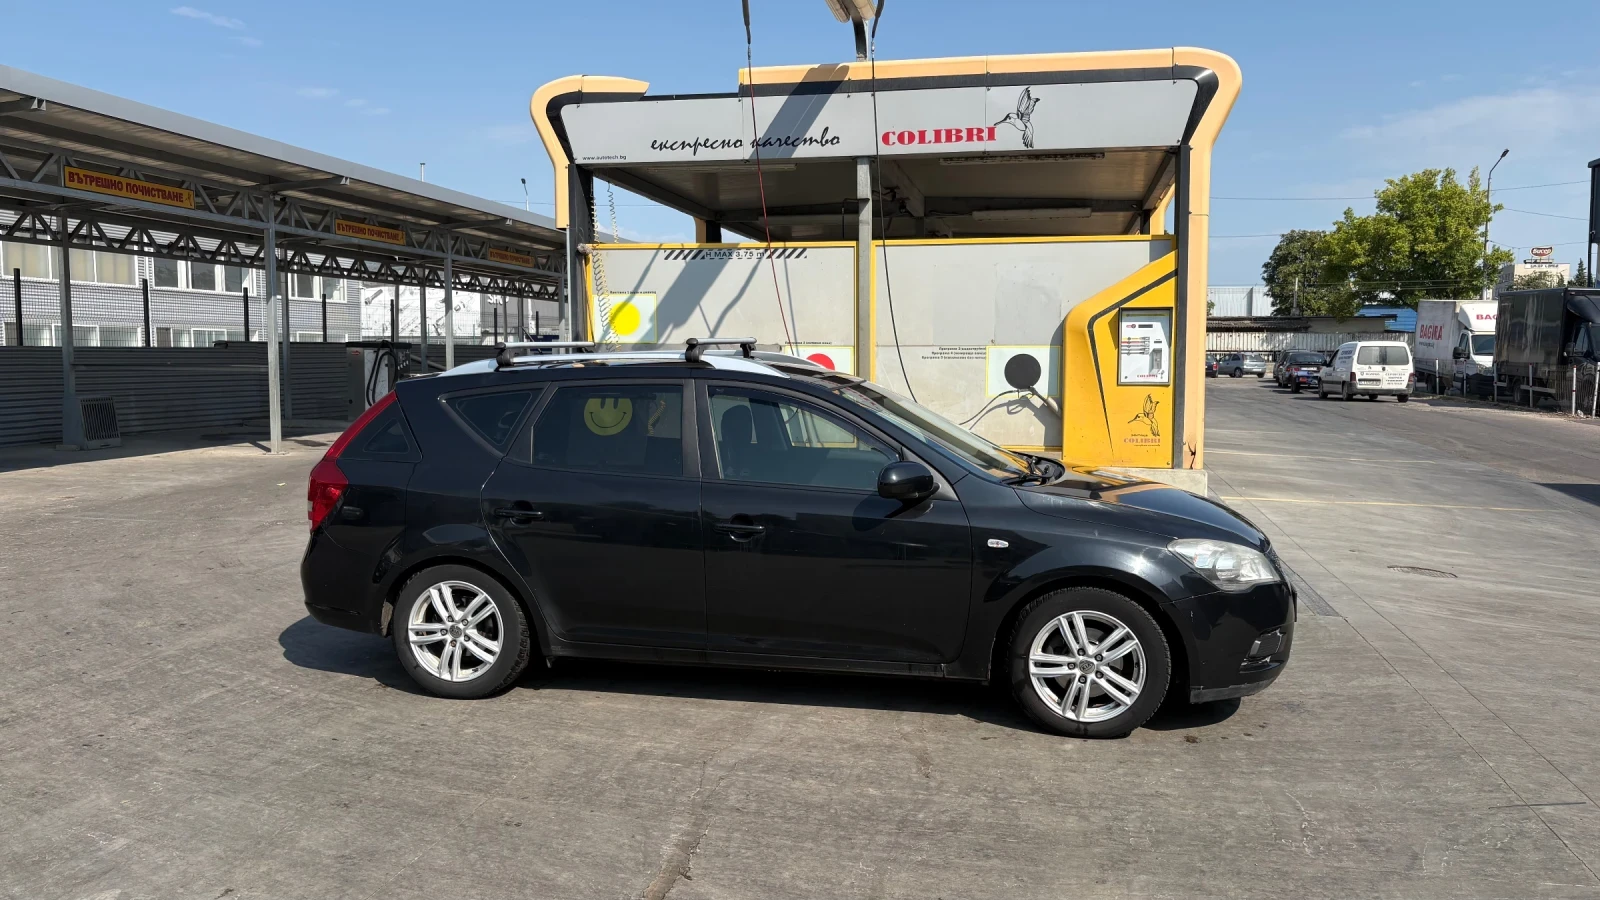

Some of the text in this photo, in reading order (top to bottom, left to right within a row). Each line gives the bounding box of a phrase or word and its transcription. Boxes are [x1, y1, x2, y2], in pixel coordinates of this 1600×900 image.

[650, 126, 841, 156] експресно качество
[881, 126, 997, 146] COLIBRI
[68, 171, 184, 203] ВЪТРЕШНО ПОЧИСТВАНЕ
[337, 222, 400, 241] ВЪТРЕШНО ПОЧИСТВАНЕ
[1419, 324, 1443, 341] BAGIRA
